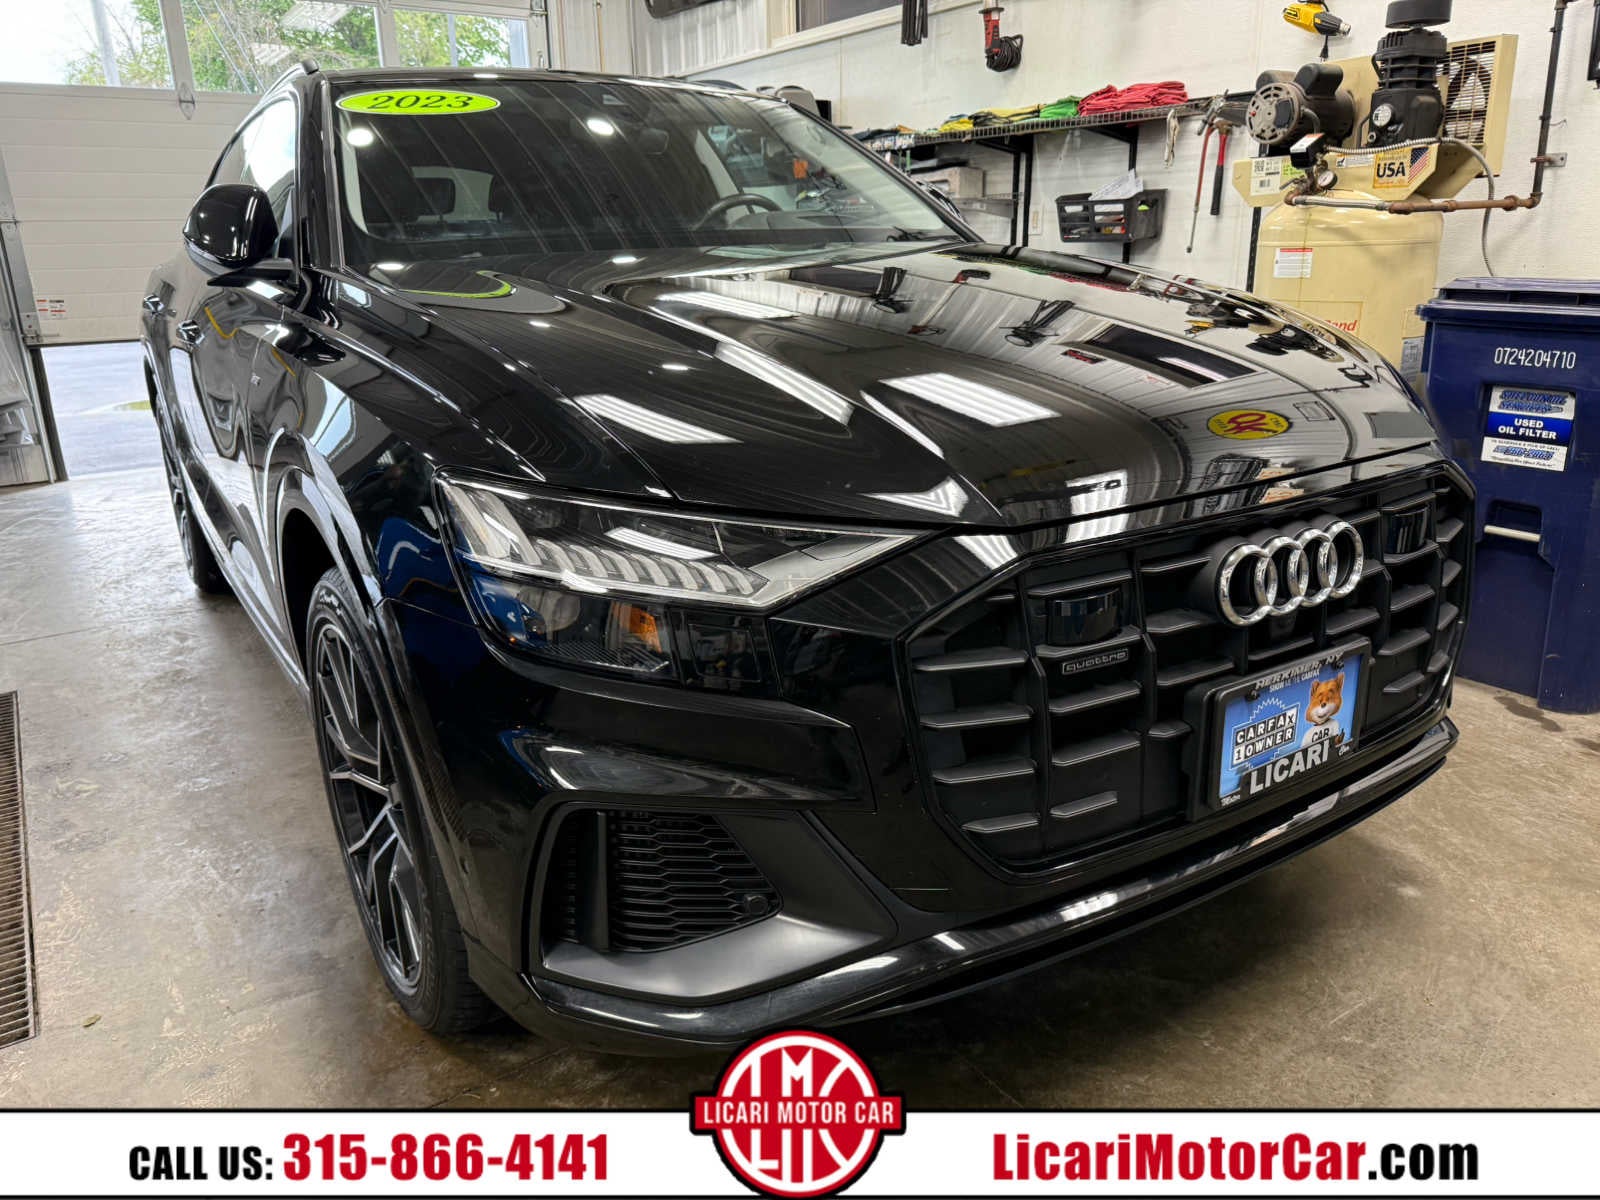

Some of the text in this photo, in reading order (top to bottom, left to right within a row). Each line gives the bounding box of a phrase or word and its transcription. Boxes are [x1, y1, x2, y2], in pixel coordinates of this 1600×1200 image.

[367, 95, 473, 110] 2023
[1376, 161, 1406, 178] USA
[1494, 347, 1577, 369] 0724204710
[1514, 418, 1544, 428] USED
[1498, 425, 1557, 440] OIL FILTER
[1235, 710, 1297, 746] CARFAX
[1312, 727, 1330, 744] CAR
[1250, 742, 1331, 795] LICARI
